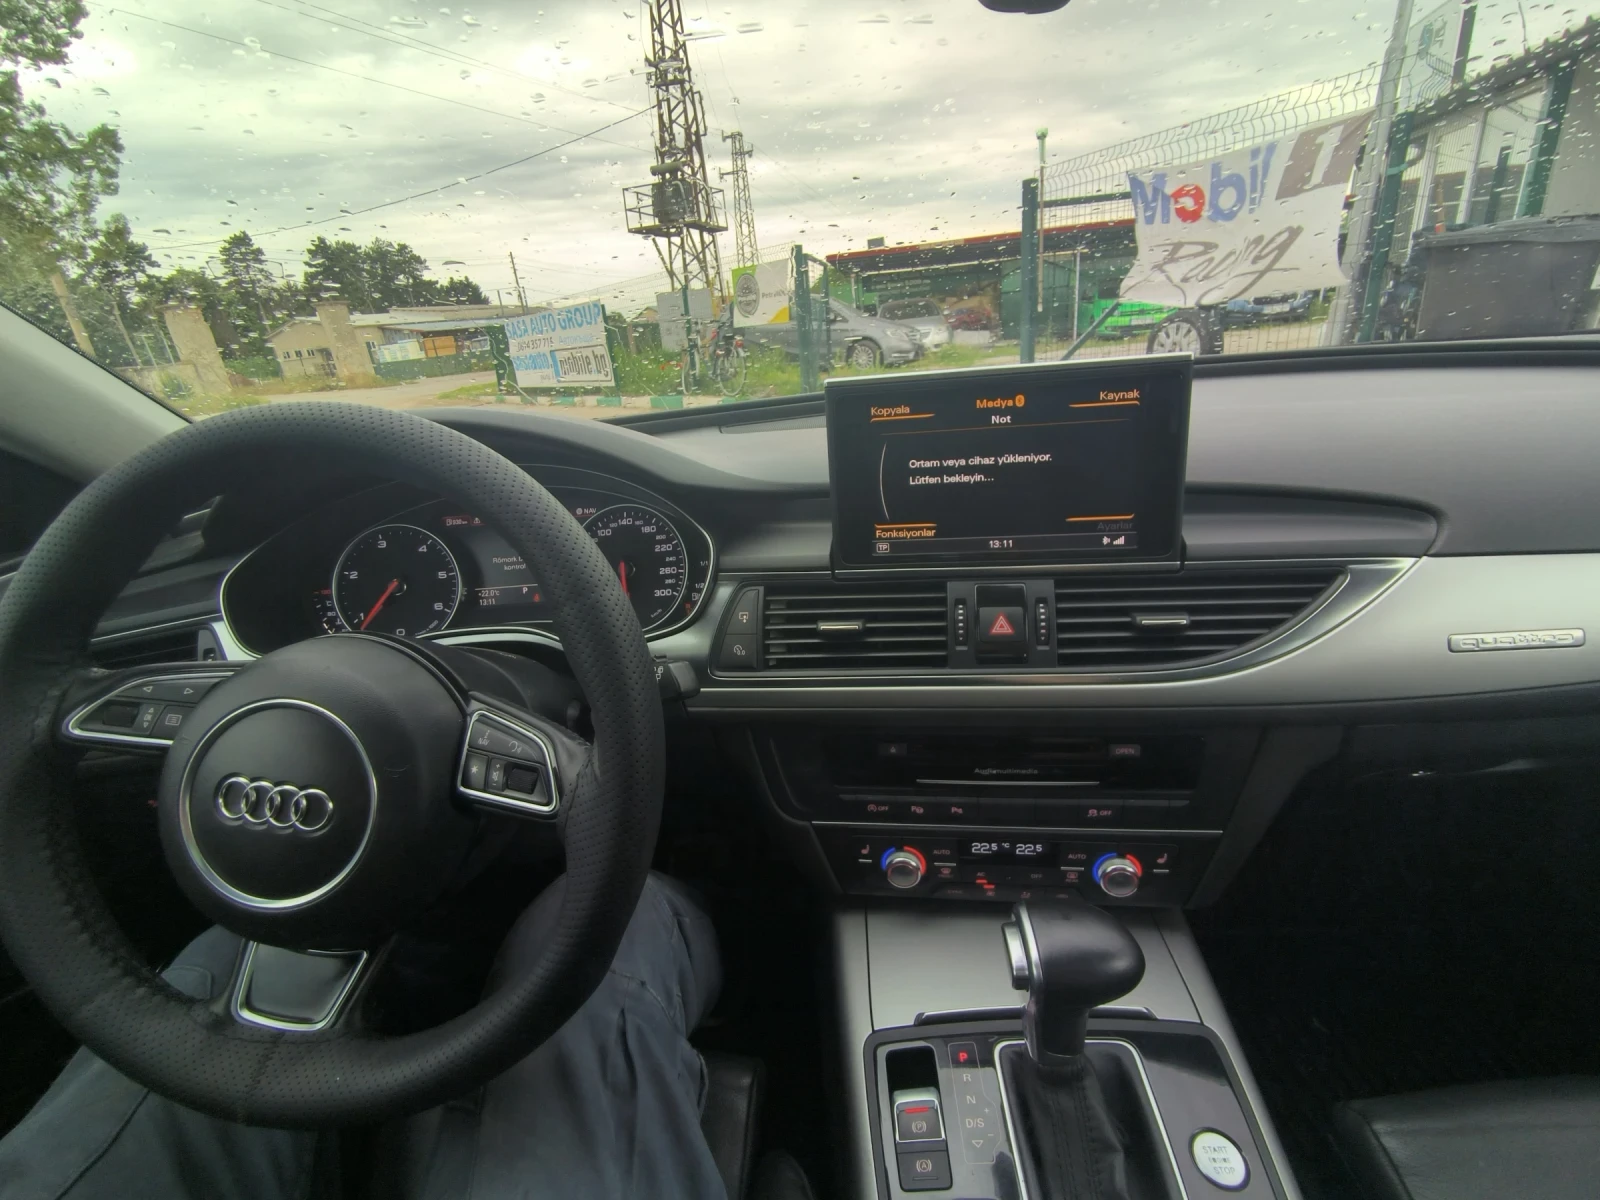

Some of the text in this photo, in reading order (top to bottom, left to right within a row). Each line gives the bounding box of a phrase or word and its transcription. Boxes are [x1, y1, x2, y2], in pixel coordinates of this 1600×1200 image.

[1127, 125, 1344, 225] Mobil 1
[506, 304, 601, 338] SASA AUTO GROUP
[531, 338, 542, 350] 357
[559, 350, 609, 378] mobile.bg
[1099, 389, 1141, 402] Kaynak
[976, 397, 1013, 409] Medya
[870, 405, 911, 416] Kopyala
[991, 415, 1012, 425] Not
[909, 453, 1053, 469] Ortam veya cihaz yükleniyor.
[909, 473, 994, 485] Lütfen bekleyin...
[618, 517, 633, 526] 140
[641, 525, 656, 533] 180
[1096, 521, 1133, 532] Ayarlar
[597, 528, 611, 536] 100
[875, 529, 936, 540] Fonksiyonlar
[377, 540, 387, 548] 3
[418, 544, 427, 552] 4
[654, 543, 672, 552] 220
[878, 544, 888, 552] TP
[988, 539, 1014, 549] 13:11
[349, 571, 358, 579] 2
[659, 567, 677, 575] 260
[654, 589, 671, 597] 300
[434, 602, 444, 611] 6
[479, 598, 496, 606] 13:11
[359, 612, 364, 621] 1
[396, 628, 406, 636] 0
[1459, 632, 1576, 651] quattro
[971, 842, 998, 854] 22.5
[1015, 843, 1043, 856] 22.5
[958, 1052, 968, 1063] P
[963, 1073, 972, 1082] R
[966, 1095, 976, 1104] N
[965, 1118, 985, 1129] D/S
[1202, 1146, 1227, 1154] START
